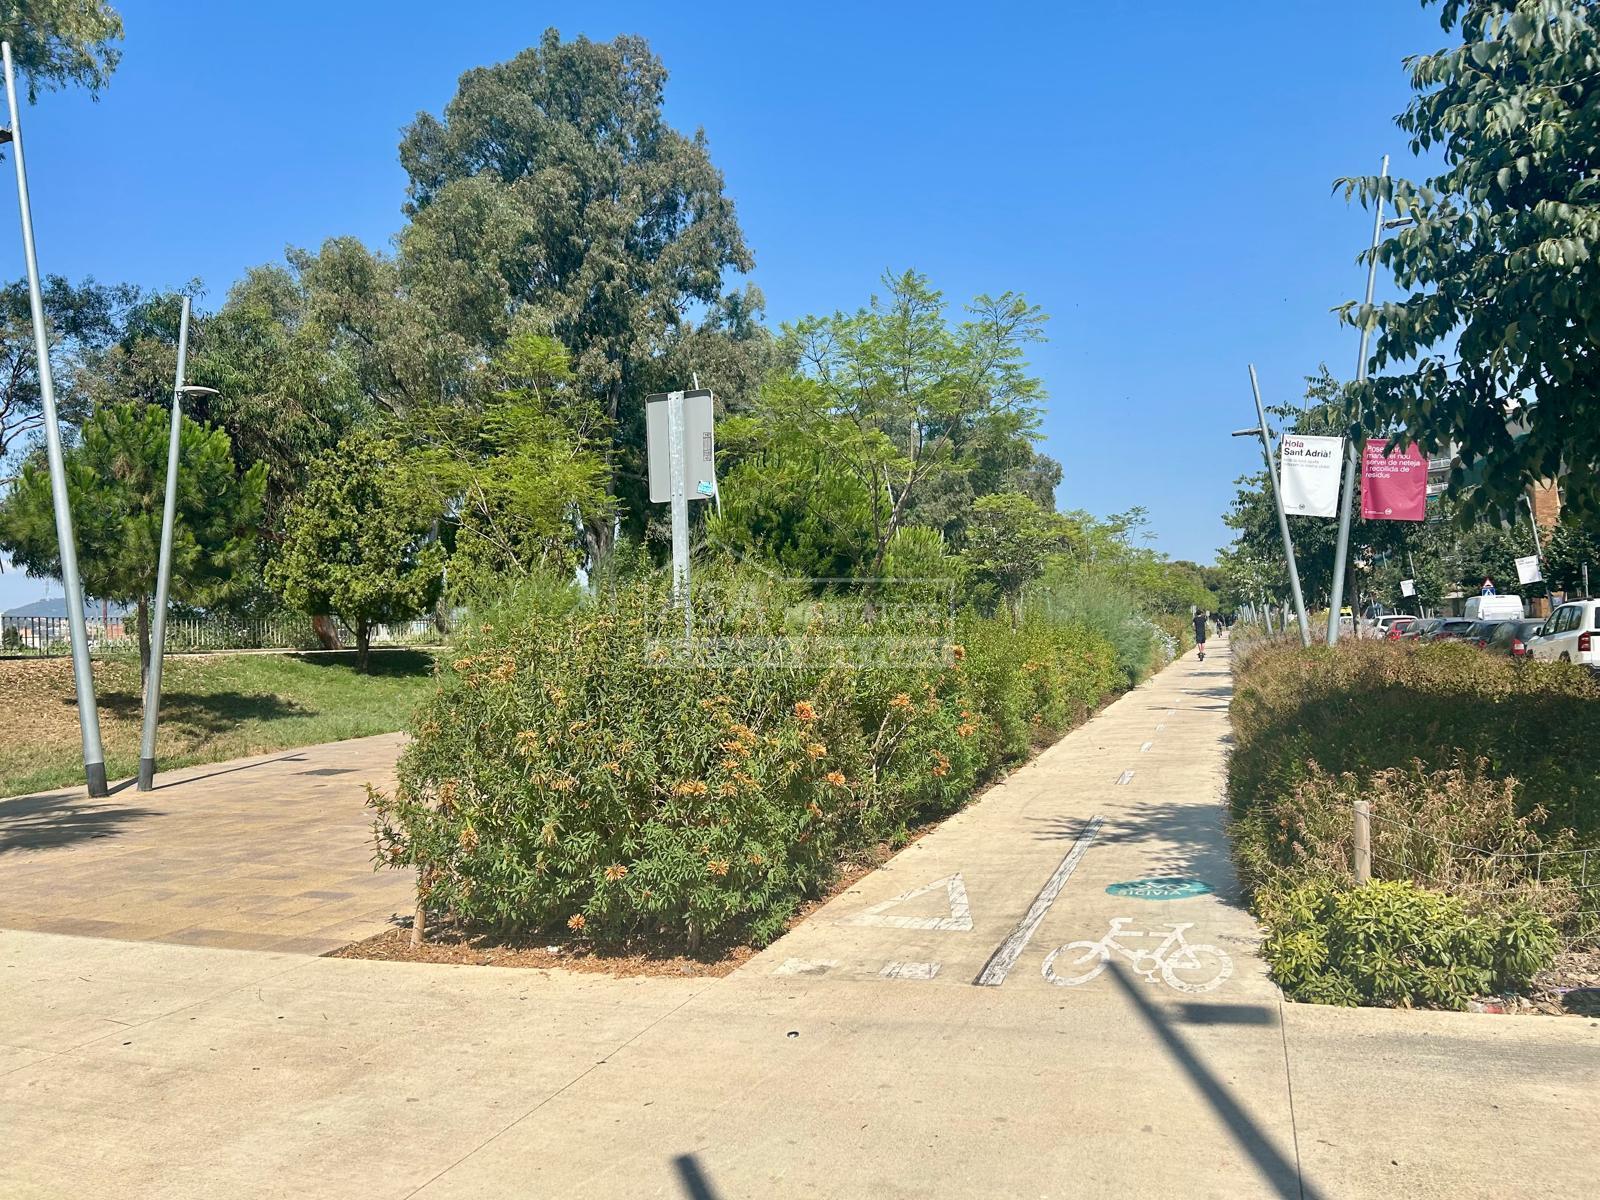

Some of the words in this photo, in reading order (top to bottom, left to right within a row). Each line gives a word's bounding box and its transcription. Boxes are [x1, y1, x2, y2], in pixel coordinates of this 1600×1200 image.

[1285, 440, 1304, 448] Hola
[1284, 448, 1303, 456] Sant
[1305, 449, 1332, 458] Adrià!
